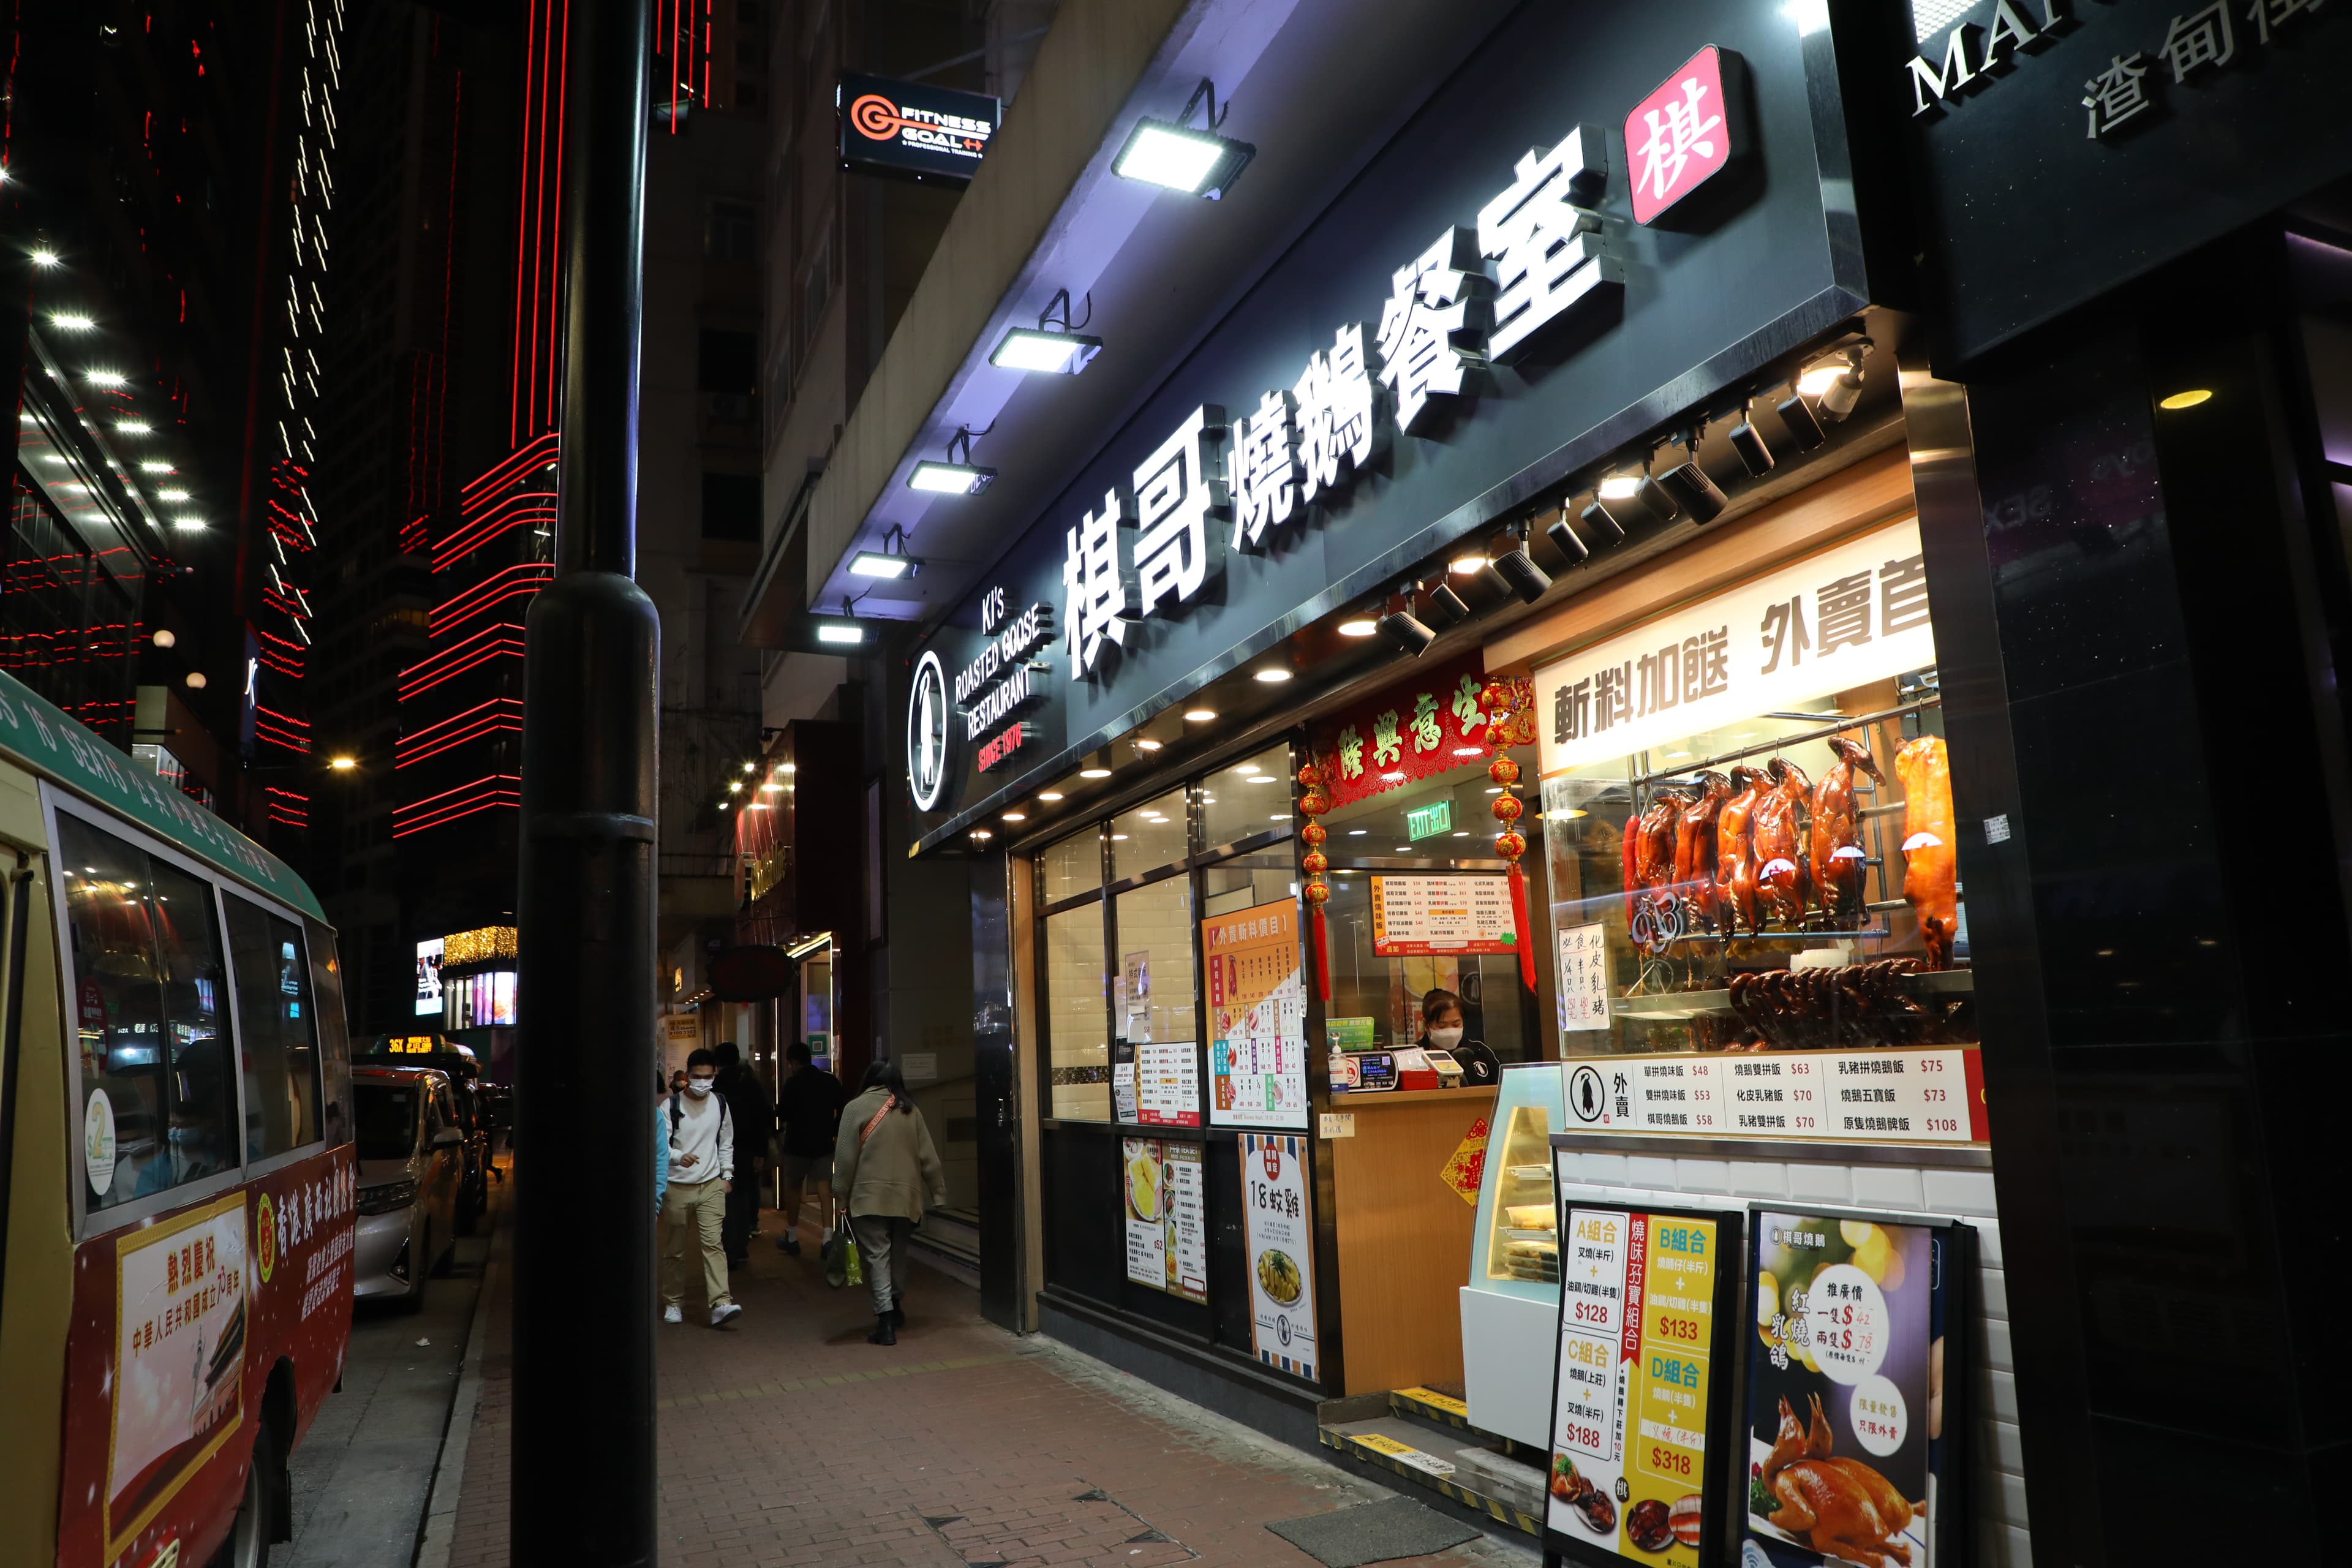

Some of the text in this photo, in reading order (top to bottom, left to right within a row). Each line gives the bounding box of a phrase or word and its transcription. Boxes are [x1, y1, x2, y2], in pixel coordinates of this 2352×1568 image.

[902, 107, 991, 134] FITNESS
[902, 127, 962, 149] GOAL
[908, 141, 978, 158] PROFESSIONAL TRAINING
[1637, 78, 1722, 200] 棋
[1063, 124, 1602, 680] 棋哥燒鵝餐室
[982, 586, 1005, 635] KI'S
[956, 601, 1041, 704] ROASTED GOOSE
[1554, 625, 1729, 745] 斬料加餸
[968, 663, 1031, 742] RESTAURANT
[22, 700, 57, 752] 16
[59, 724, 128, 794] SEATS
[978, 722, 1022, 773] SINCE 1976
[1410, 812, 1430, 839] EXIT
[1430, 802, 1450, 831] 出口
[389, 1039, 404, 1053] 36X
[1644, 1066, 1708, 1077] 單拼燒味飯 $48
[1735, 1063, 1809, 1077] 燒鵝雙拼飯 $63
[1838, 1060, 1943, 1074] 乳豬拼燒鵝飯 $75
[1613, 1072, 1629, 1118] 外賣
[1646, 1090, 1710, 1101] 雙拼燒味飯 $53
[1737, 1089, 1812, 1102] 化皮乳豬飯 $70
[1841, 1088, 1947, 1103] 燒鵝五寶飯 $73
[1648, 1113, 1713, 1125] 棋哥燒鵝飯 $58
[1739, 1114, 1814, 1128] 乳豬雙拼飯 $70
[1843, 1117, 1958, 1132] 原隻燒鵝髀飯 $108
[1251, 1180, 1299, 1219] 18蚊雞
[1577, 1219, 1617, 1244] A組合
[1660, 1227, 1706, 1254] B組合
[1783, 1230, 1825, 1248] 棋哥燒鵝
[1154, 1240, 1163, 1250] $52
[1578, 1247, 1613, 1262] 叉燒(半斤)
[168, 1235, 215, 1294] 熱烈慶祝
[1657, 1256, 1708, 1276] 燒腩仔(半斤)
[1625, 1219, 1645, 1351] 燒味孖寶組合
[1827, 1283, 1863, 1302] 推廣價
[133, 1265, 239, 1358] 中華人民共和國成立73周年
[1575, 1300, 1608, 1324] $128
[1790, 1288, 1811, 1347] 紅燒
[1660, 1315, 1698, 1340] $133
[1568, 1340, 1609, 1368] C組合
[1770, 1313, 1789, 1371] 乳鴿
[1569, 1367, 1606, 1387] 燒鵝(上莊)
[1652, 1357, 1700, 1389] D組合
[1653, 1386, 1696, 1409] 燒鵝(半隻)
[1567, 1401, 1604, 1423] 叉燒(半斤)
[1567, 1422, 1600, 1449] $188
[1860, 1420, 1898, 1441] 只限外賣
[1652, 1446, 1691, 1476] $318
